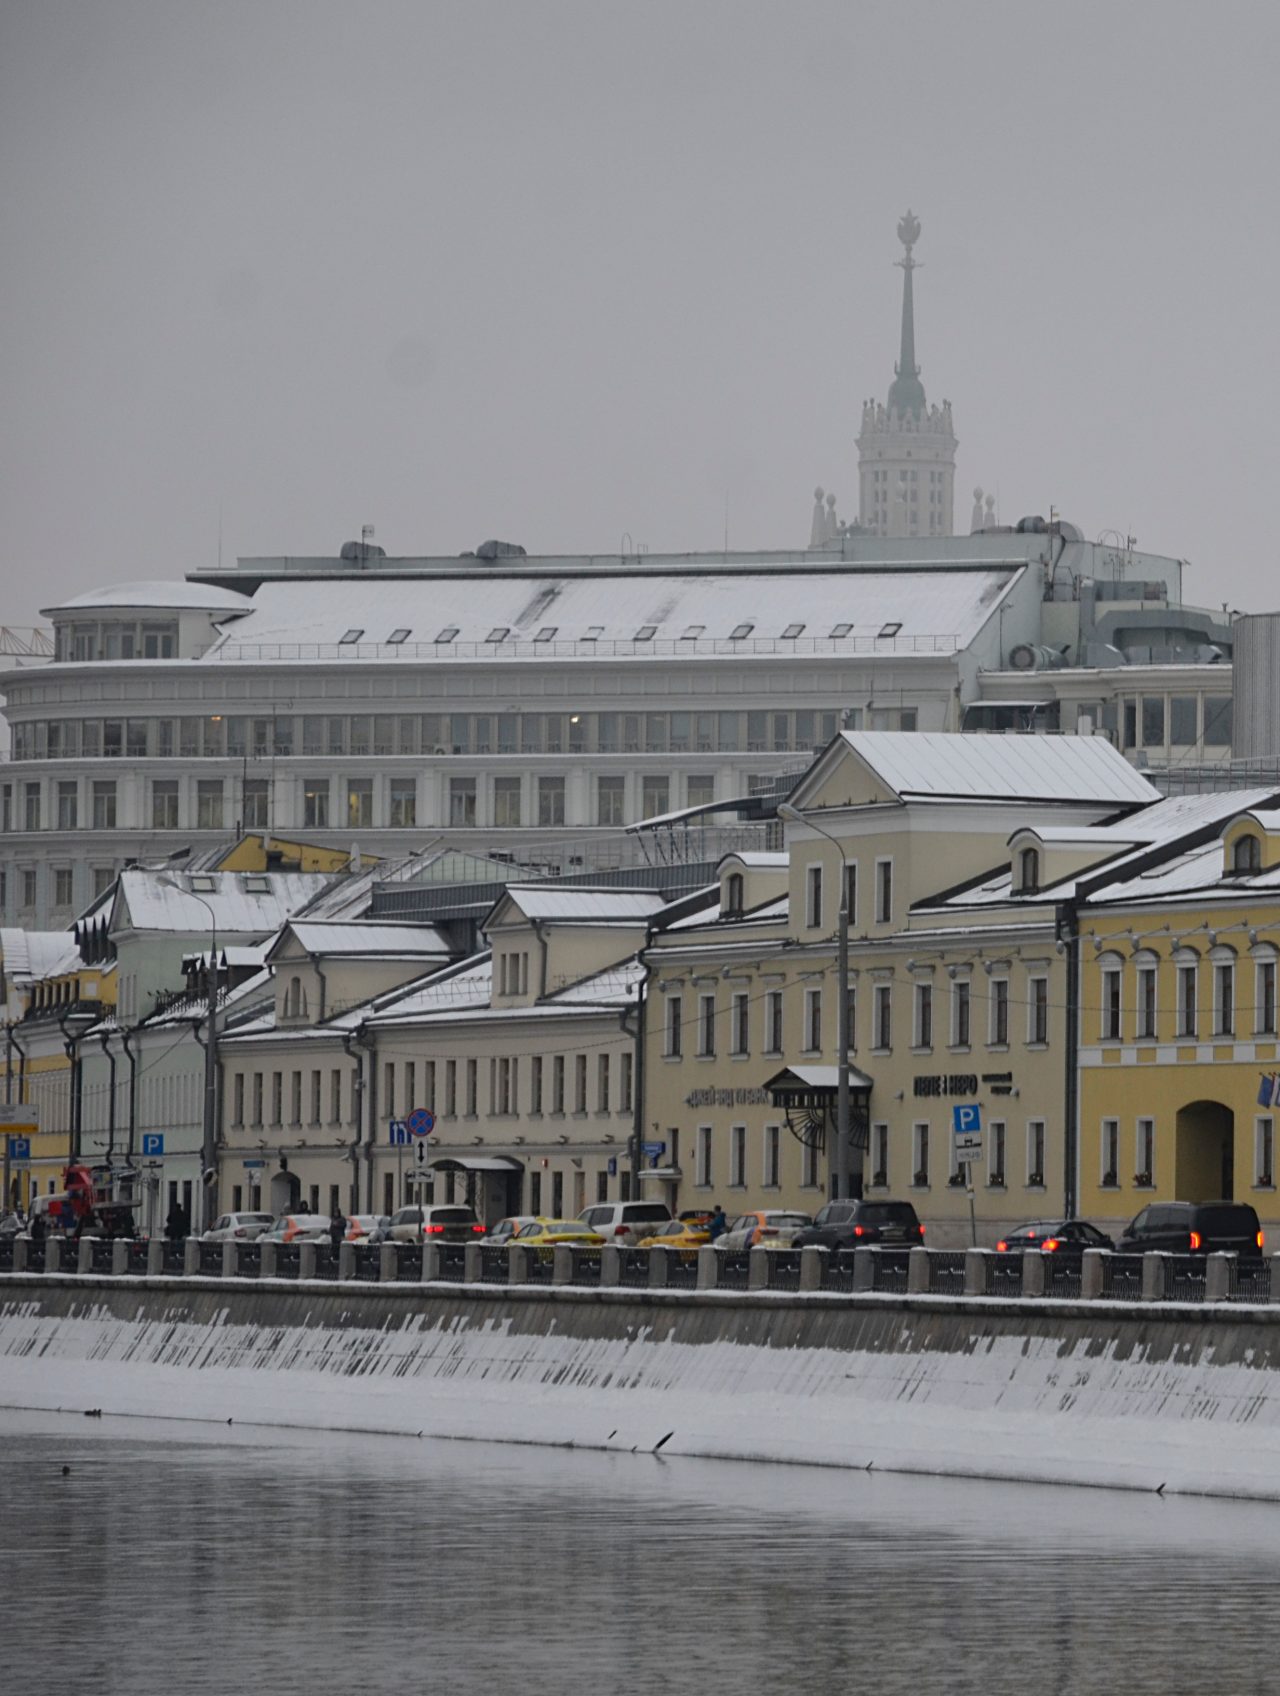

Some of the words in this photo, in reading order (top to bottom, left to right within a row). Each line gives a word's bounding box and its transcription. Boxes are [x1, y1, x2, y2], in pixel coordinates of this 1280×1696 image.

[960, 1108, 974, 1130] P
[15, 1140, 27, 1157] P
[148, 1136, 160, 1153] P
